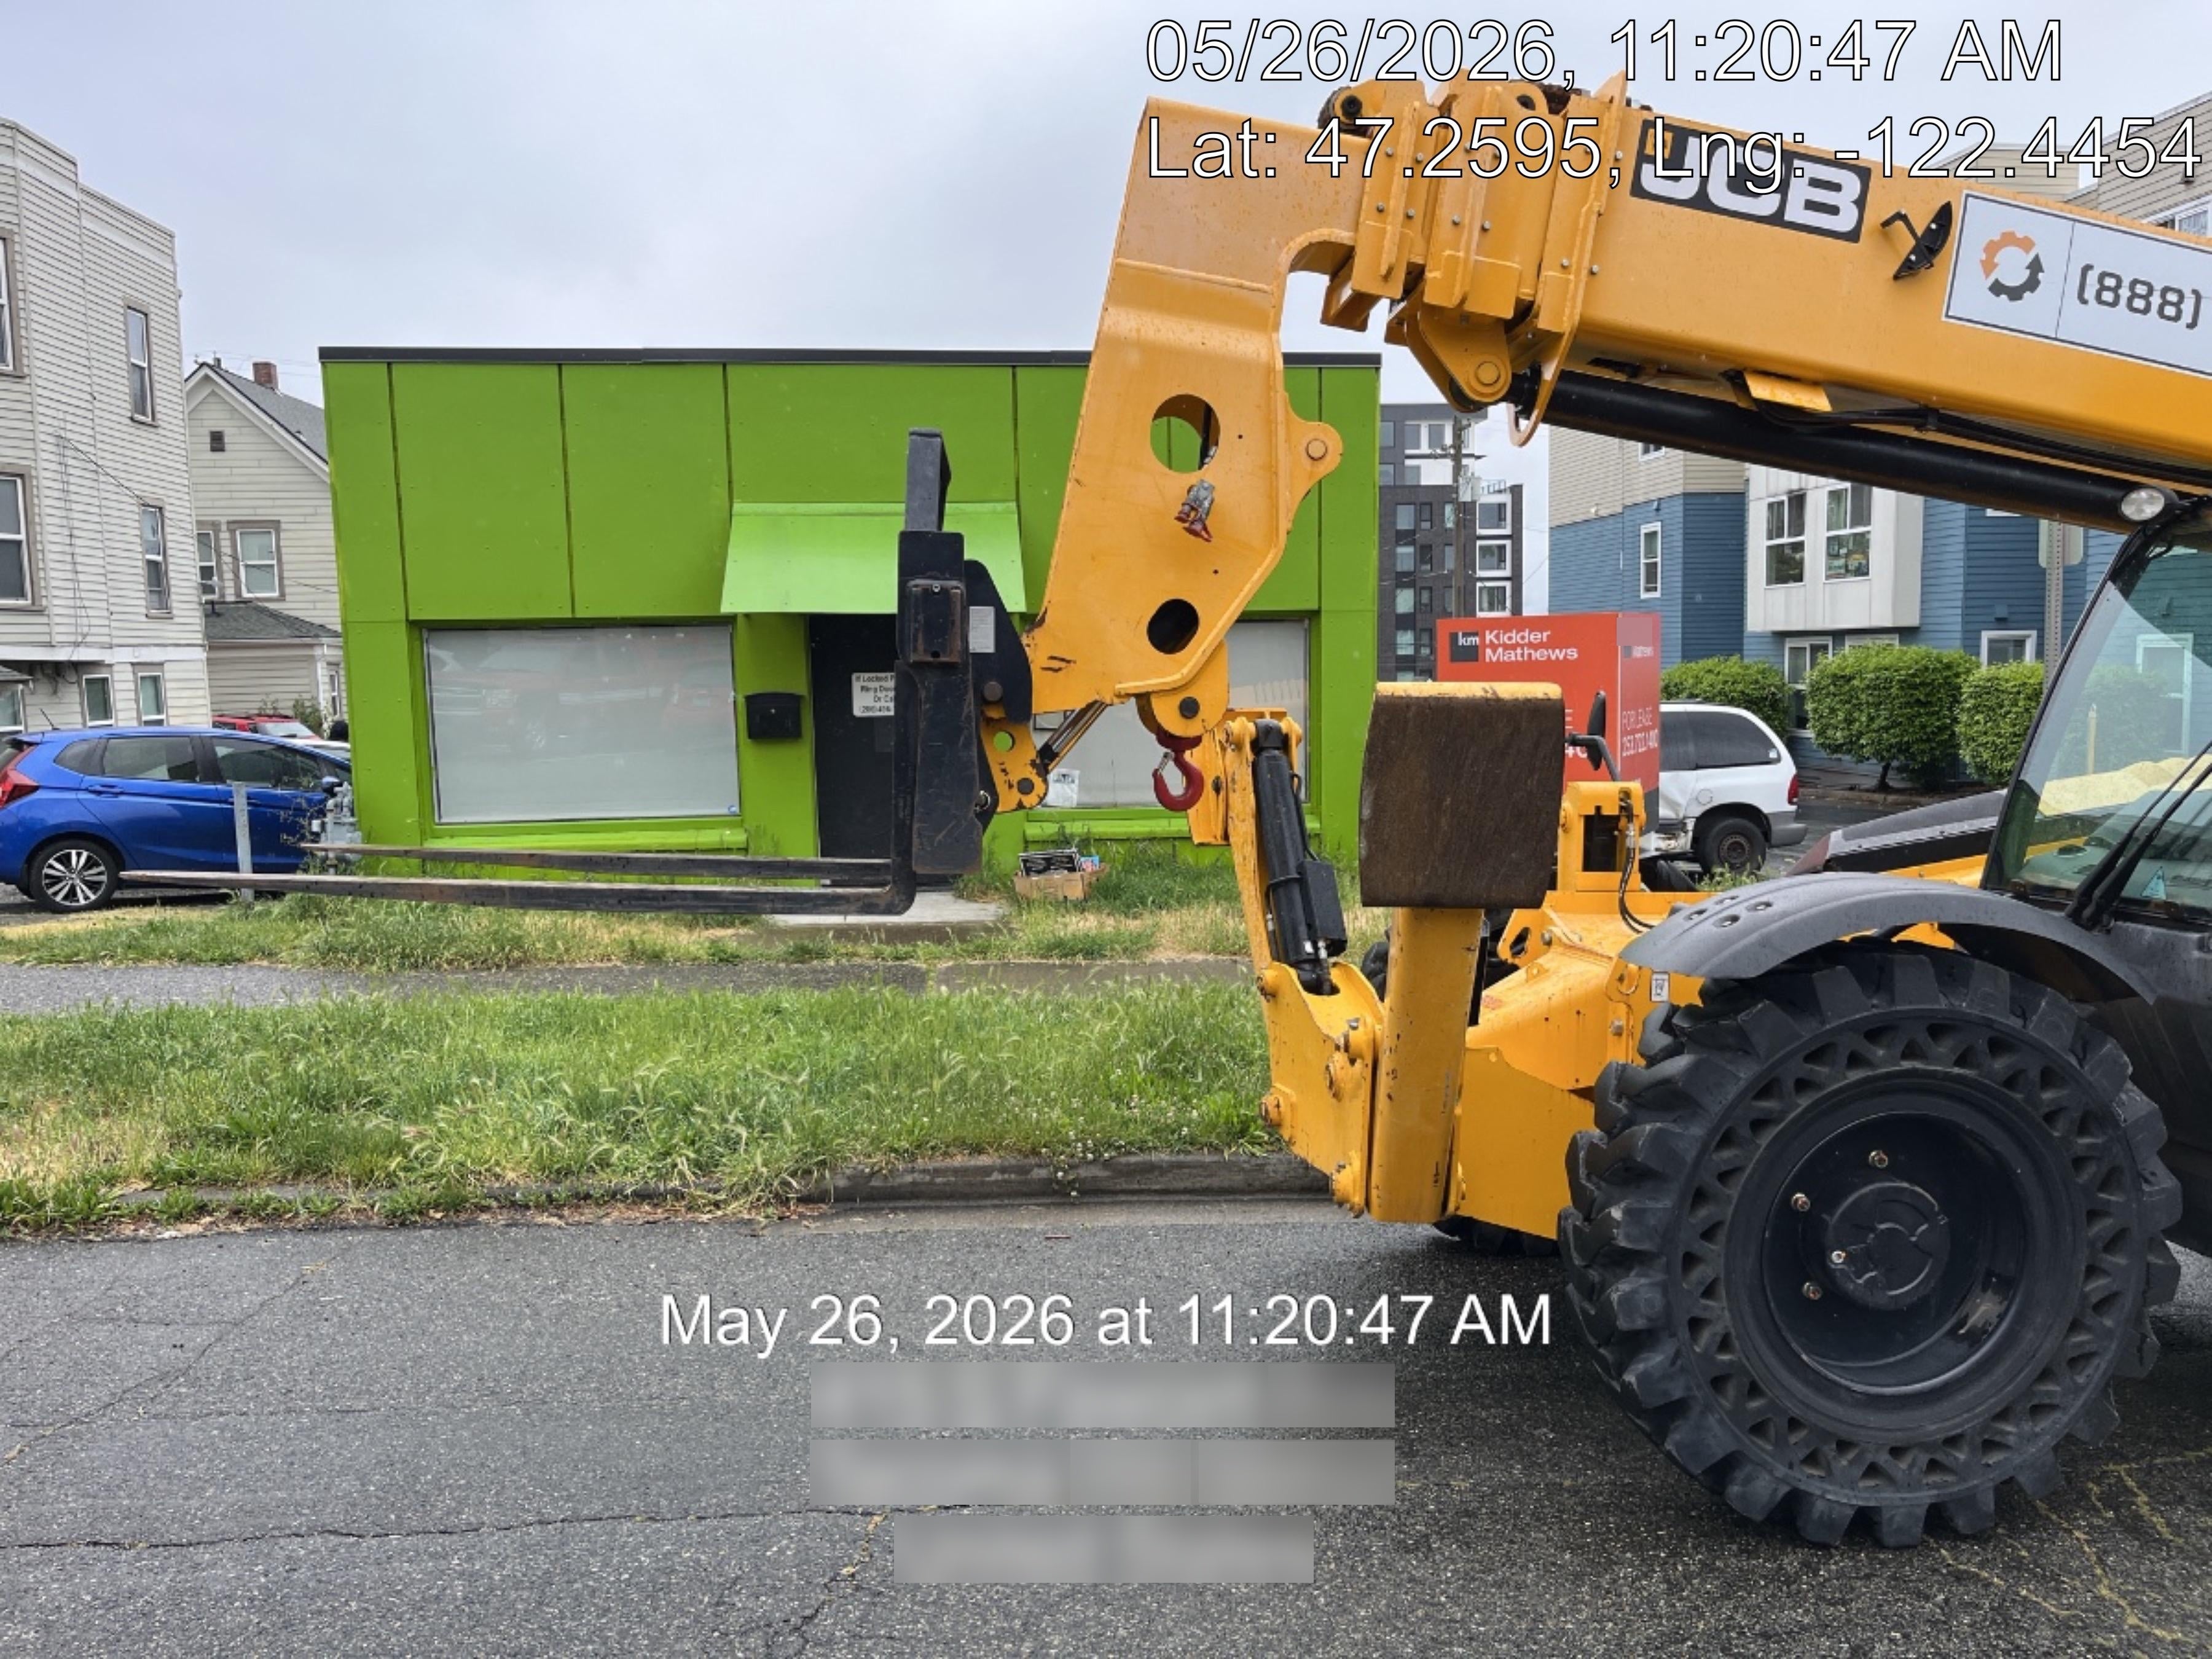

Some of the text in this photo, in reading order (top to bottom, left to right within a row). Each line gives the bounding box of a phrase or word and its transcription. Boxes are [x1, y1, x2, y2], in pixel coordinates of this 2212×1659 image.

[1639, 136, 1861, 235] JCB
[2077, 263, 2202, 329] (888)
[1457, 631, 1479, 646] km
[1484, 629, 1551, 645] Kidder
[1484, 646, 1579, 663] Mathews
